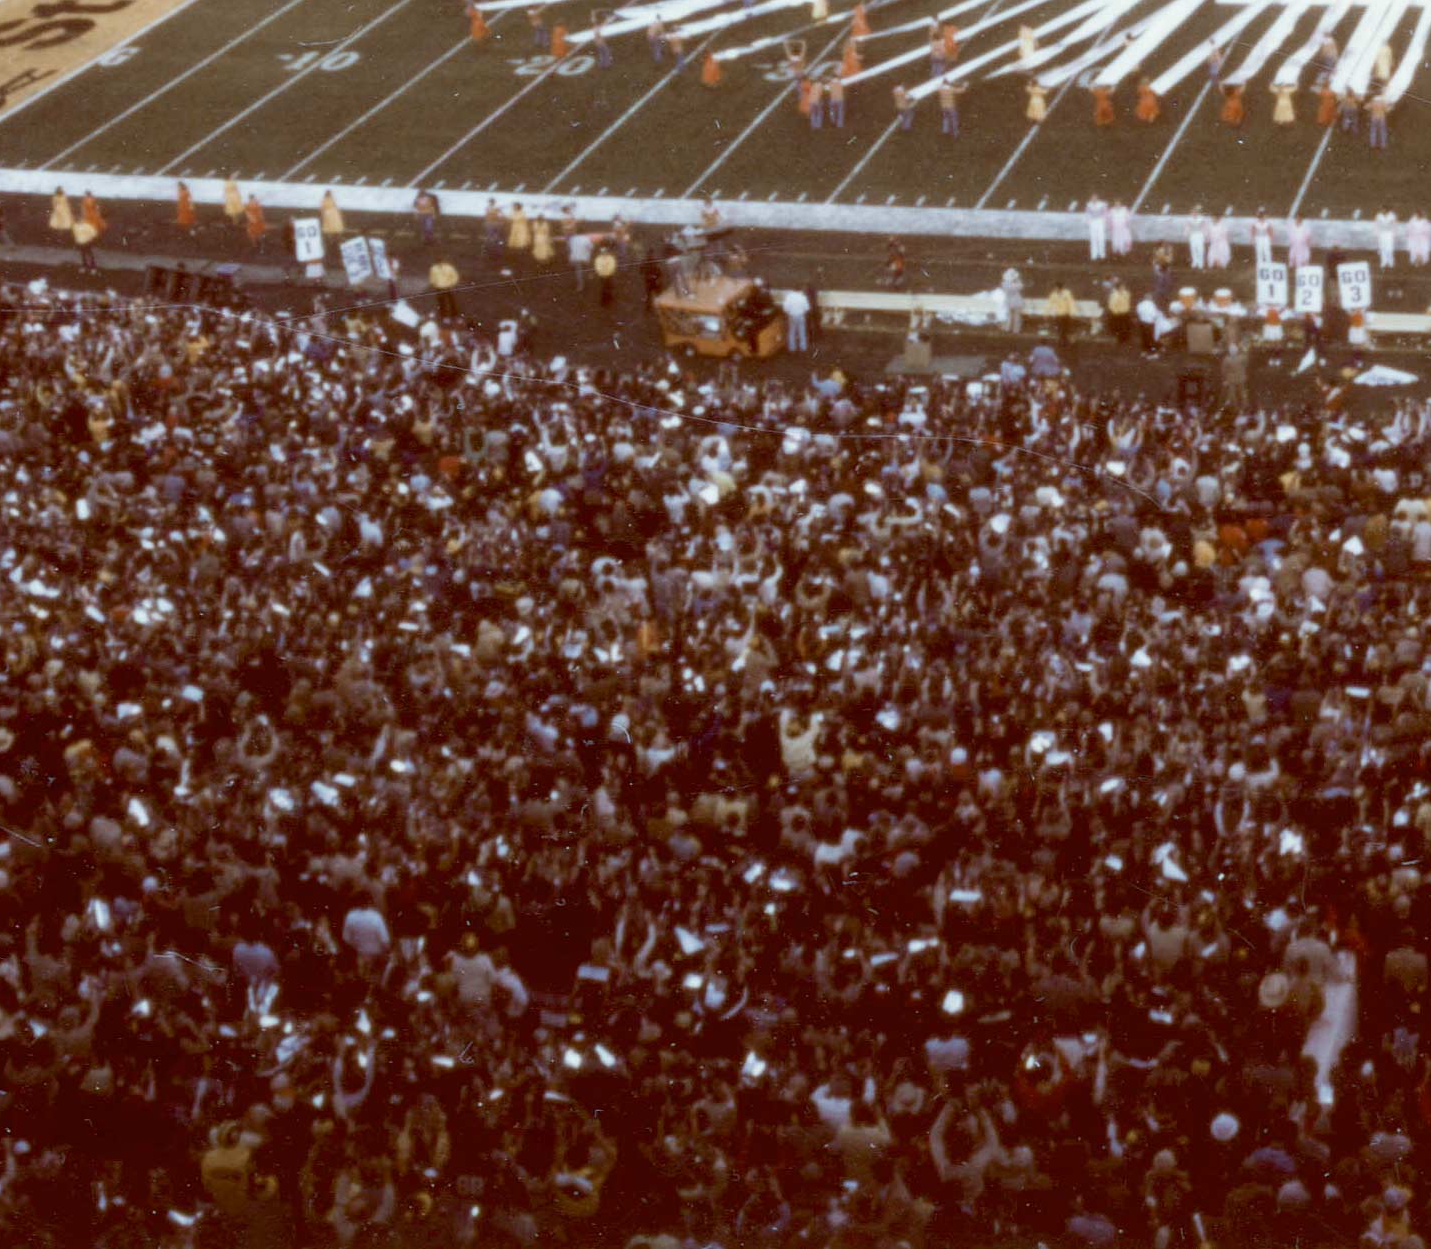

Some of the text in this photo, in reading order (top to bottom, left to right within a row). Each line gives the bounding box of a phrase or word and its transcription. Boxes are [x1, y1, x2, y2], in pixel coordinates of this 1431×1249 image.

[285, 51, 360, 71] 10
[513, 55, 595, 76] 20
[1259, 267, 1283, 281] GO
[1298, 274, 1320, 287] GO
[1341, 270, 1366, 283] GO
[1301, 289, 1313, 305] 2
[1350, 286, 1362, 303] 3
